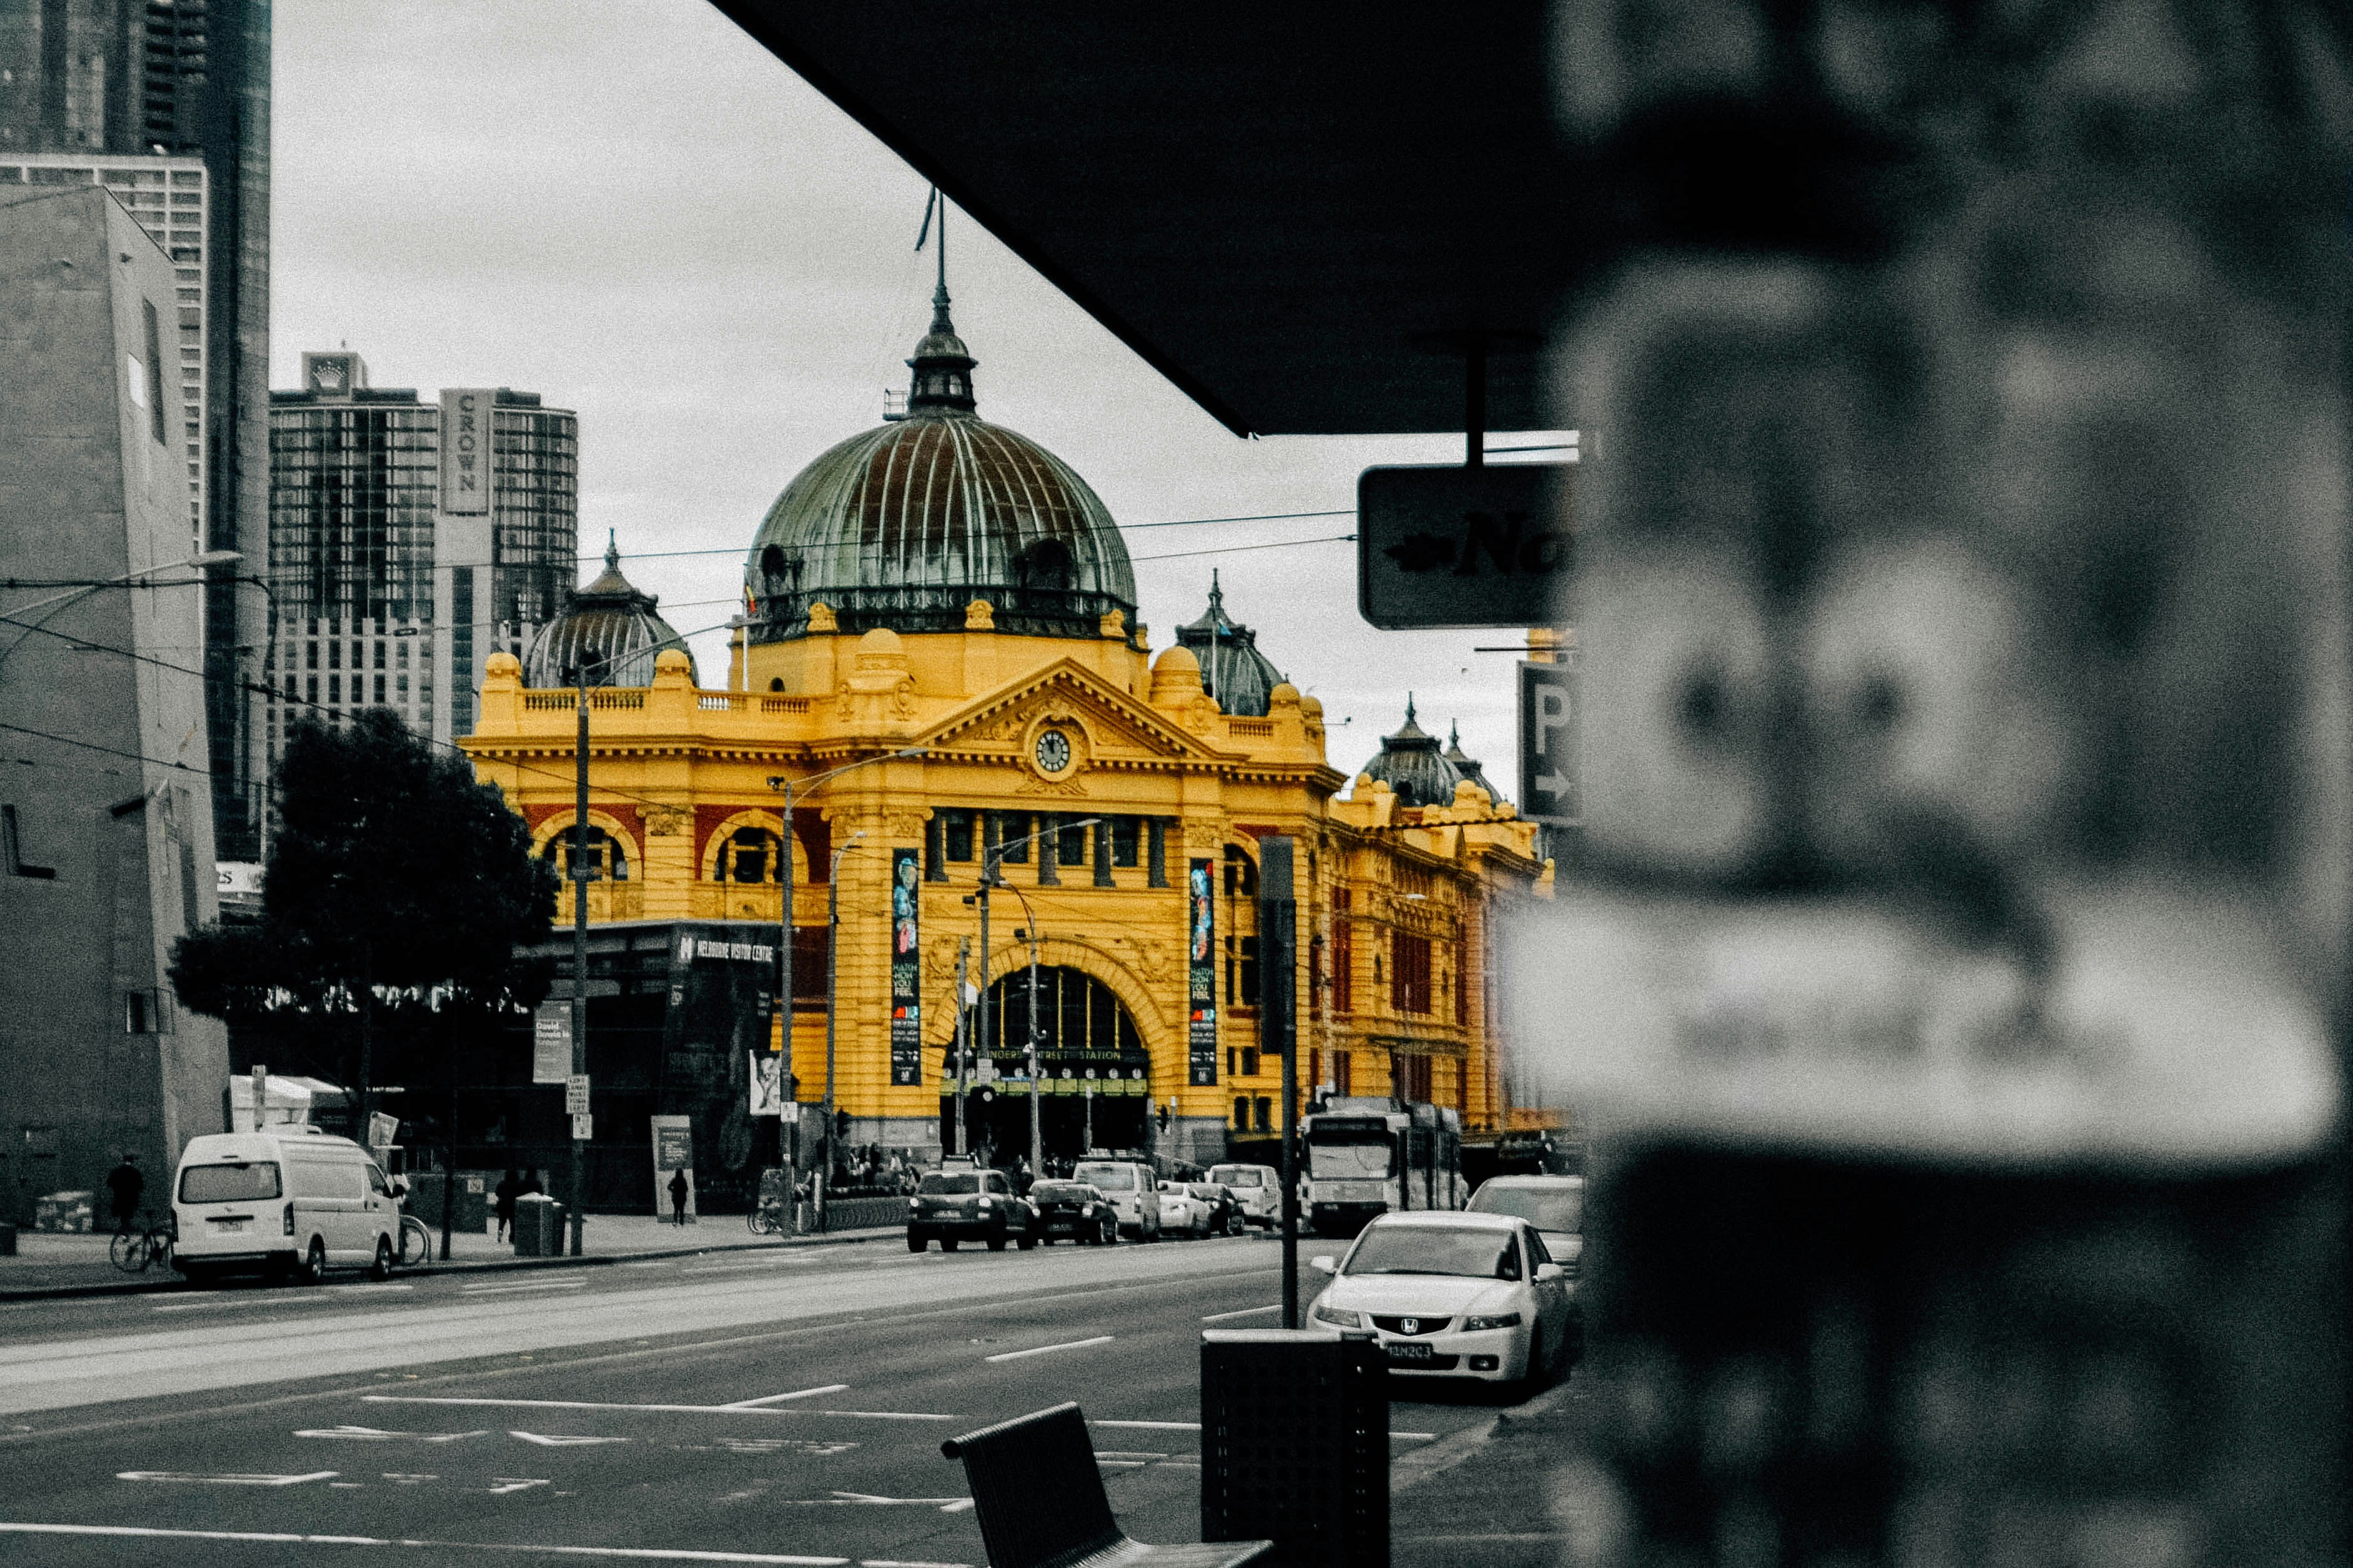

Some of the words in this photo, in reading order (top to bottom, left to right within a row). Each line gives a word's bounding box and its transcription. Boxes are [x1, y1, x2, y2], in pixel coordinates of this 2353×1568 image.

[458, 395, 476, 491] CROWN
[1534, 683, 1572, 755] P
[697, 940, 729, 959] MELBOURNE
[730, 943, 752, 961] VISITOR
[752, 945, 773, 963] CENTRE
[1080, 1051, 1121, 1060] STATION
